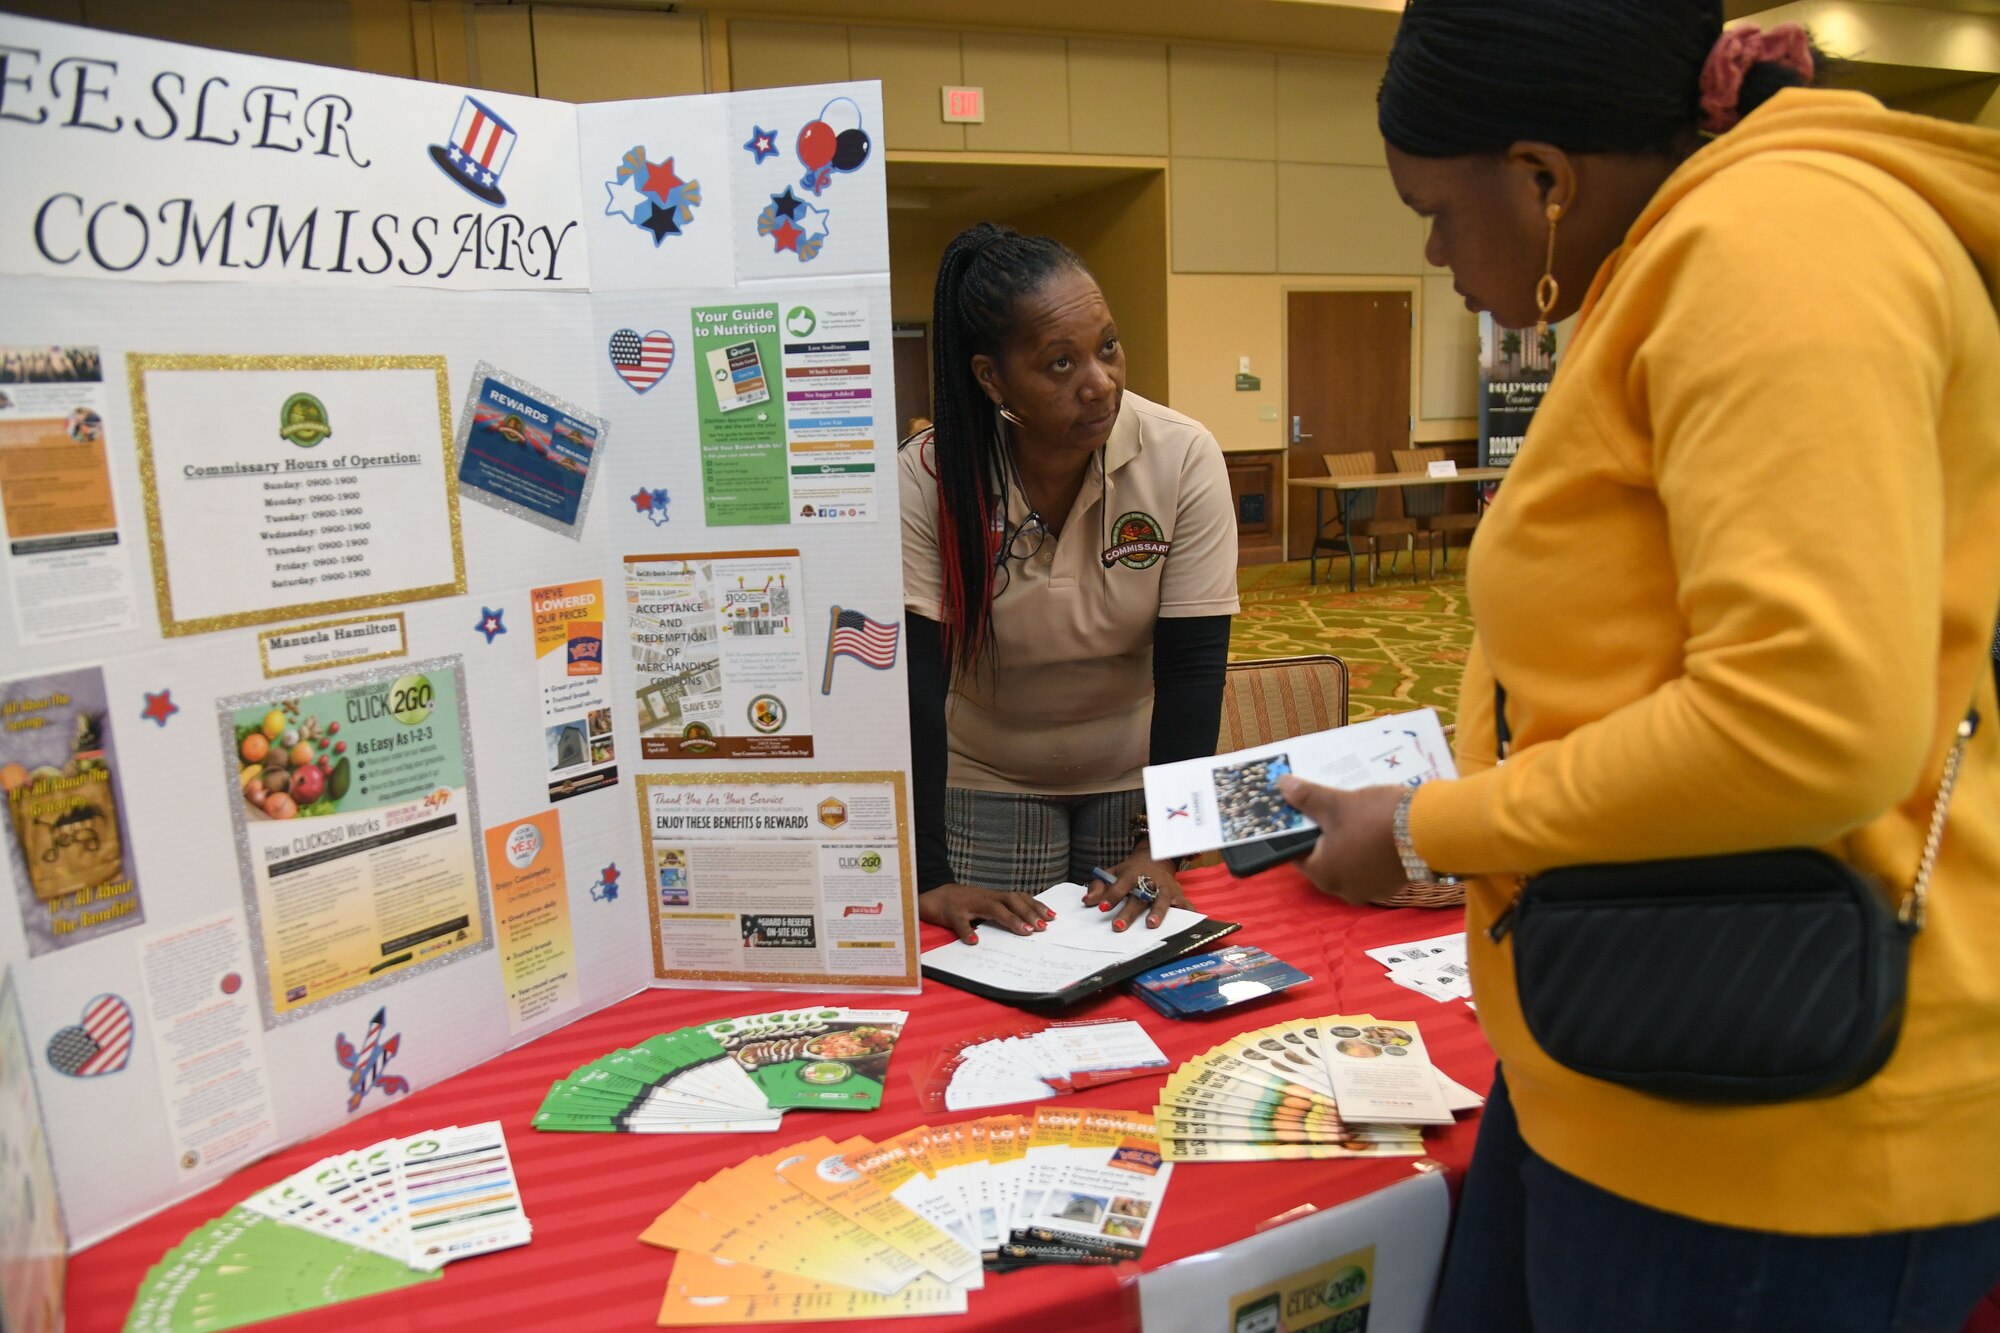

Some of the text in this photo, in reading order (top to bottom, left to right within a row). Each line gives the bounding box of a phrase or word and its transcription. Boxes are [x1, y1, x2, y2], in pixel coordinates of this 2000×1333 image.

[949, 91, 978, 116] EXIT
[35, 191, 577, 280] COMMISSARY
[696, 308, 774, 323] Your Guide
[695, 323, 776, 337] to Nutrition
[815, 390, 833, 399] Sugar
[834, 389, 855, 397] Added
[490, 389, 549, 424] REWARDS
[1489, 436, 1525, 454] BOOMT
[183, 452, 421, 477] Commissary Hours of Operation:
[534, 587, 563, 600] WE'VE
[535, 593, 596, 613] LOWERED
[636, 602, 704, 614] ACCEPTANCE
[536, 607, 588, 625] OUR PRICES
[659, 618, 683, 628] AND
[270, 623, 397, 649] Manuela Hamilton
[637, 632, 707, 644] REDEMPTION
[666, 647, 681, 657] OF
[636, 661, 713, 672] MERCHANDISE
[650, 677, 702, 686] COUPONS
[683, 702, 706, 713] SAVE
[356, 726, 433, 756] As Easy As 1-2-3
[654, 791, 784, 806] Thank You for Your Service
[656, 815, 809, 829] ENJOY THESE BENEFITS & REWARDS
[264, 844, 290, 859] How
[347, 818, 381, 838] Works
[511, 838, 537, 855] YES!
[761, 917, 812, 927] GUARD & RESERVE
[766, 927, 809, 937] ON-SITE SALES
[1160, 959, 1216, 979] REWARDS
[1082, 1124, 1110, 1134] OUR
[1084, 1116, 1157, 1133] LOWERE
[856, 1147, 906, 1171] LOWE
